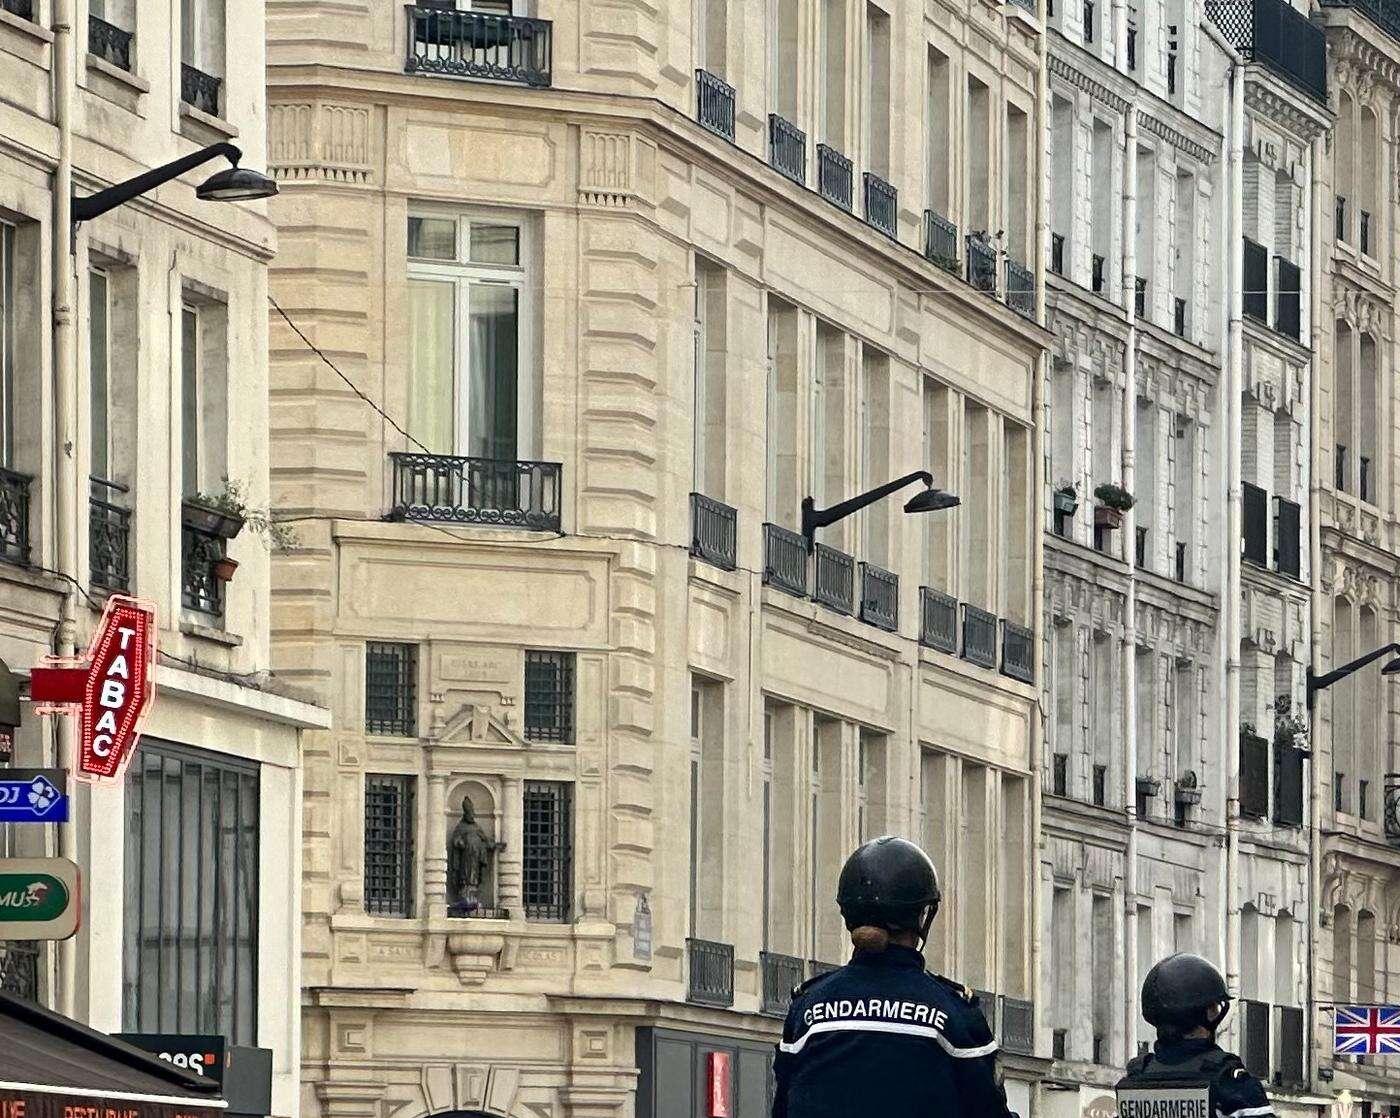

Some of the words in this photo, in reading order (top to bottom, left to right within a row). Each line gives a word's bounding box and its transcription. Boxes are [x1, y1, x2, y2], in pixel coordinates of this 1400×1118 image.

[92, 626, 136, 757] TABAC
[803, 999, 948, 1030] GENDARMERIE
[1120, 1100, 1206, 1118] GENDARMERIE
